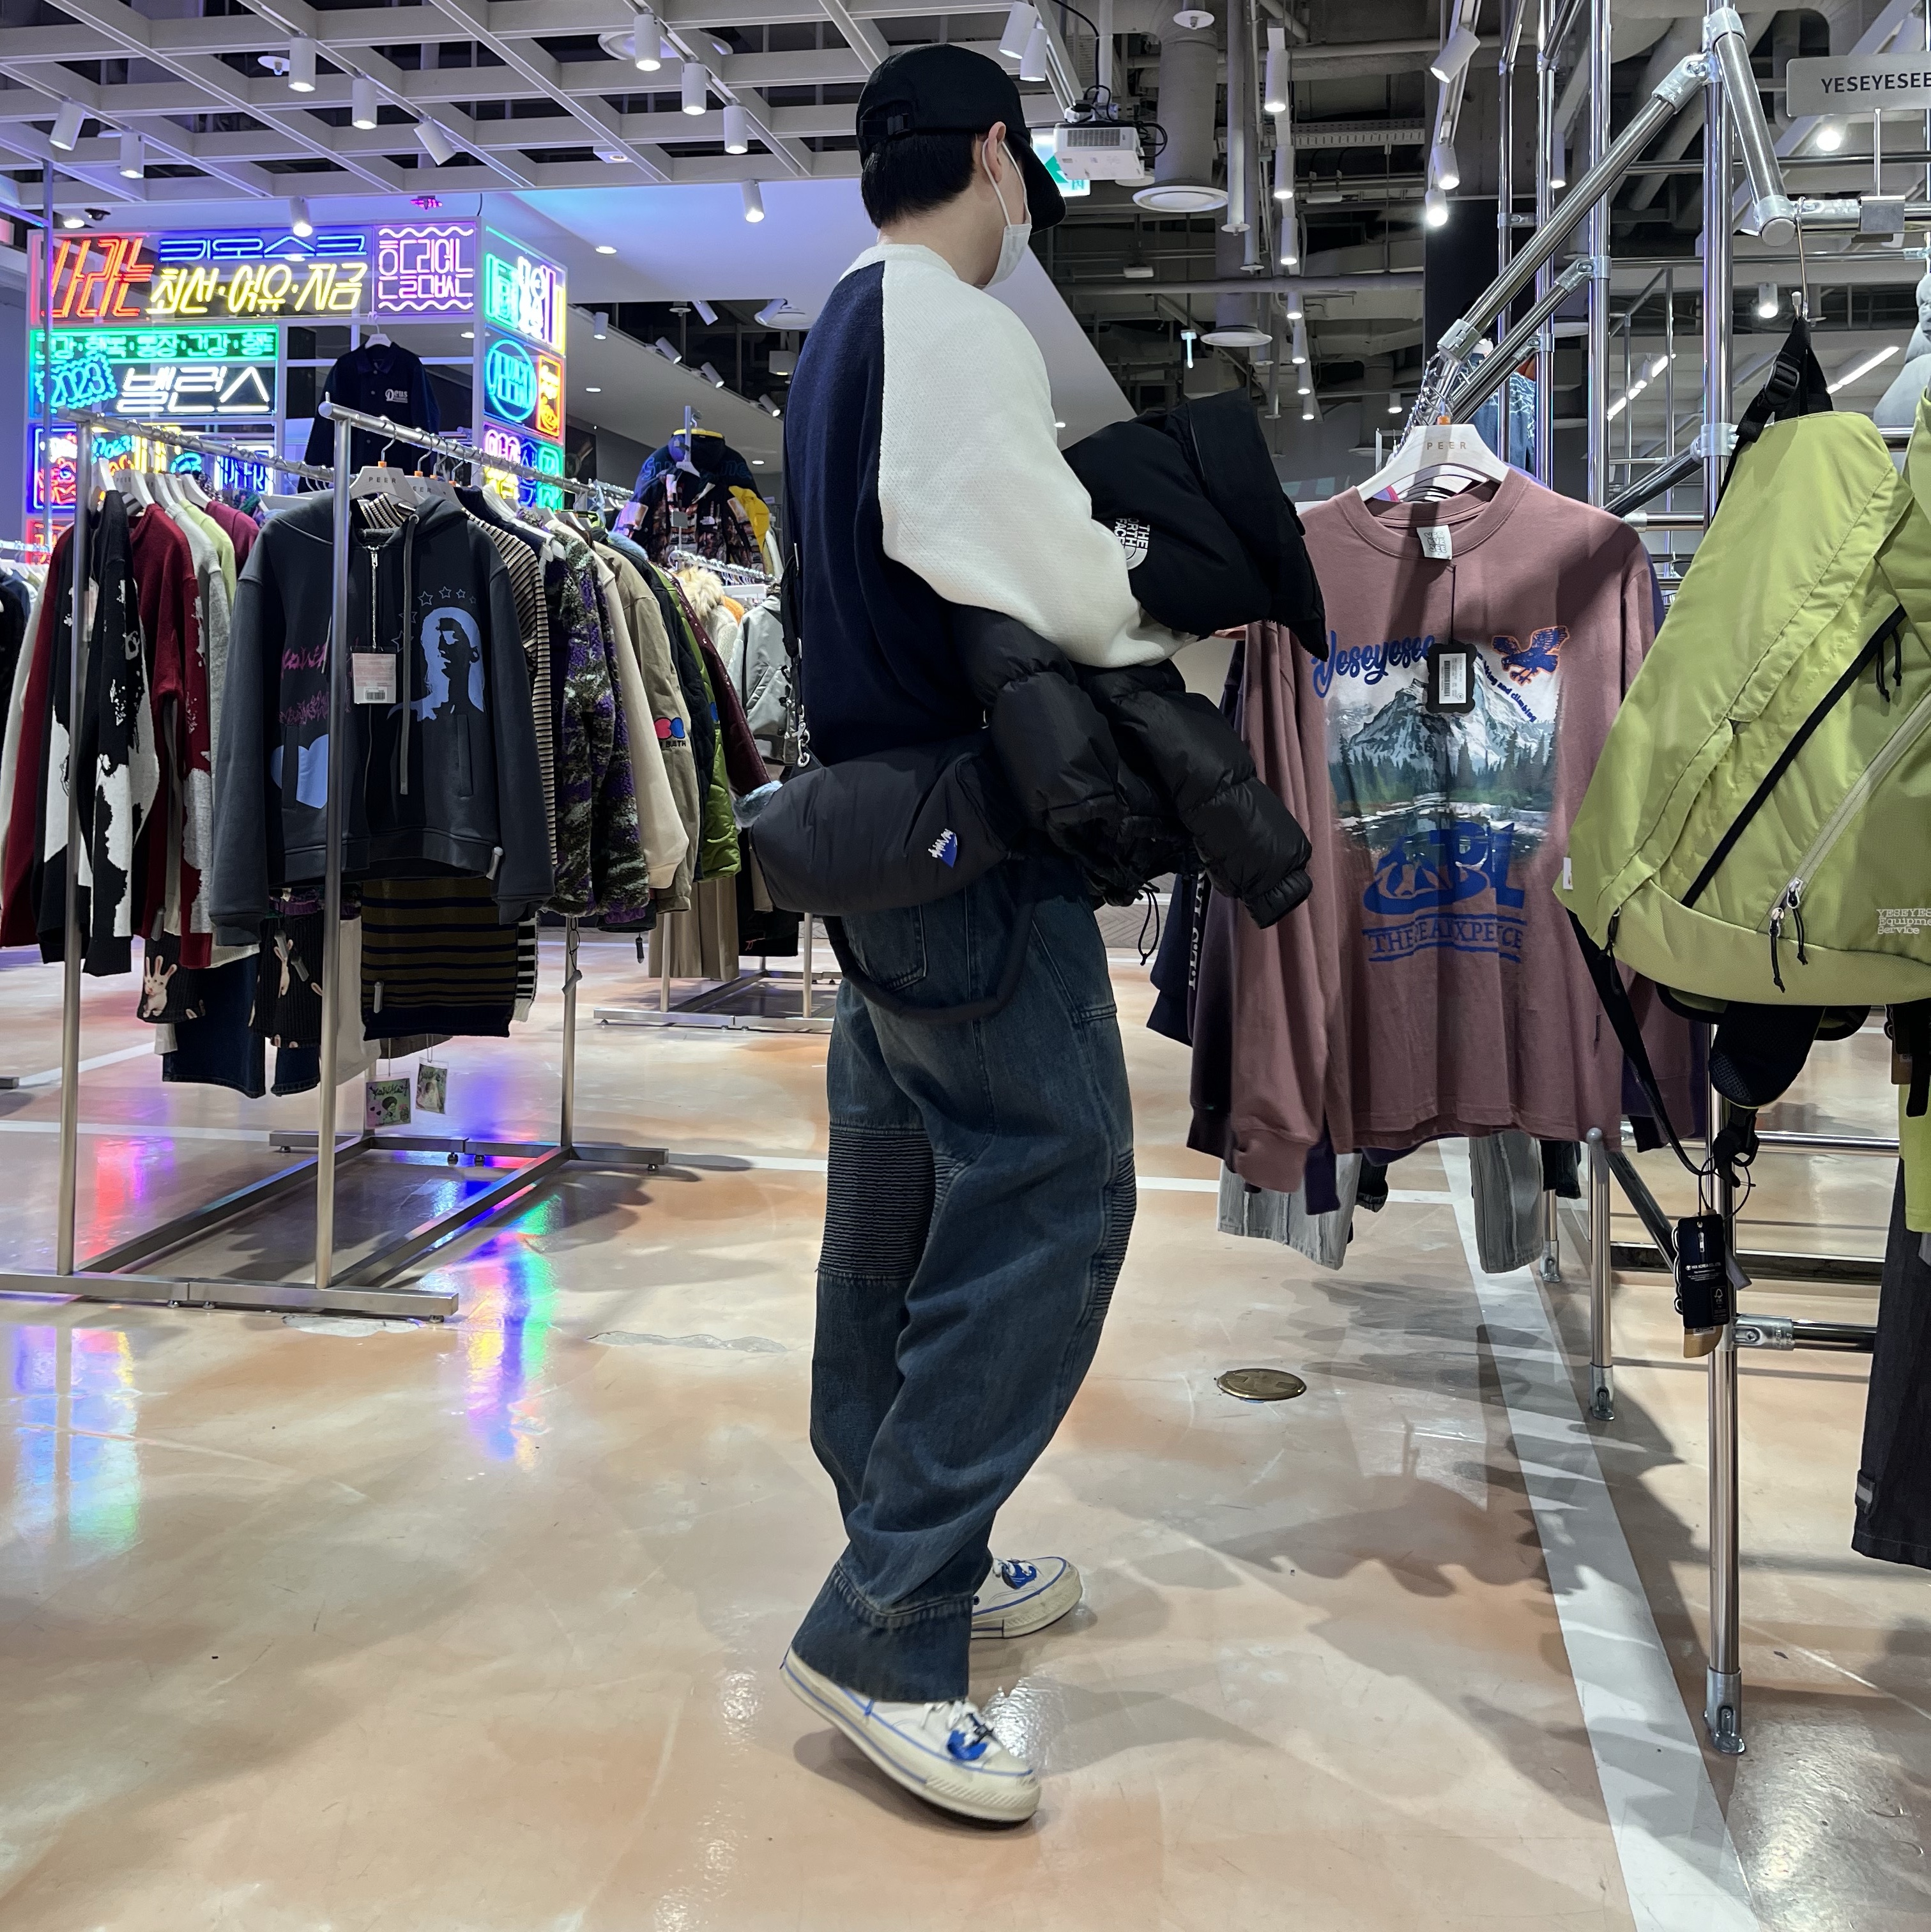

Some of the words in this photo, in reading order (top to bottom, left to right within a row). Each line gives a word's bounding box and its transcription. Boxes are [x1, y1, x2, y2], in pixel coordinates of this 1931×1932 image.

[1820, 72, 1931, 94] YESEYESEE
[159, 234, 368, 262] 키오스크
[117, 366, 270, 413] 밸런스
[385, 388, 408, 401] Deus
[1426, 441, 1467, 450] PEER
[1125, 518, 1139, 546] ORTH
[1137, 525, 1150, 548] THE
[1497, 682, 1513, 695] and
[1511, 693, 1537, 723] climbing
[666, 740, 687, 748] BATH
[1877, 925, 1920, 935] Service
